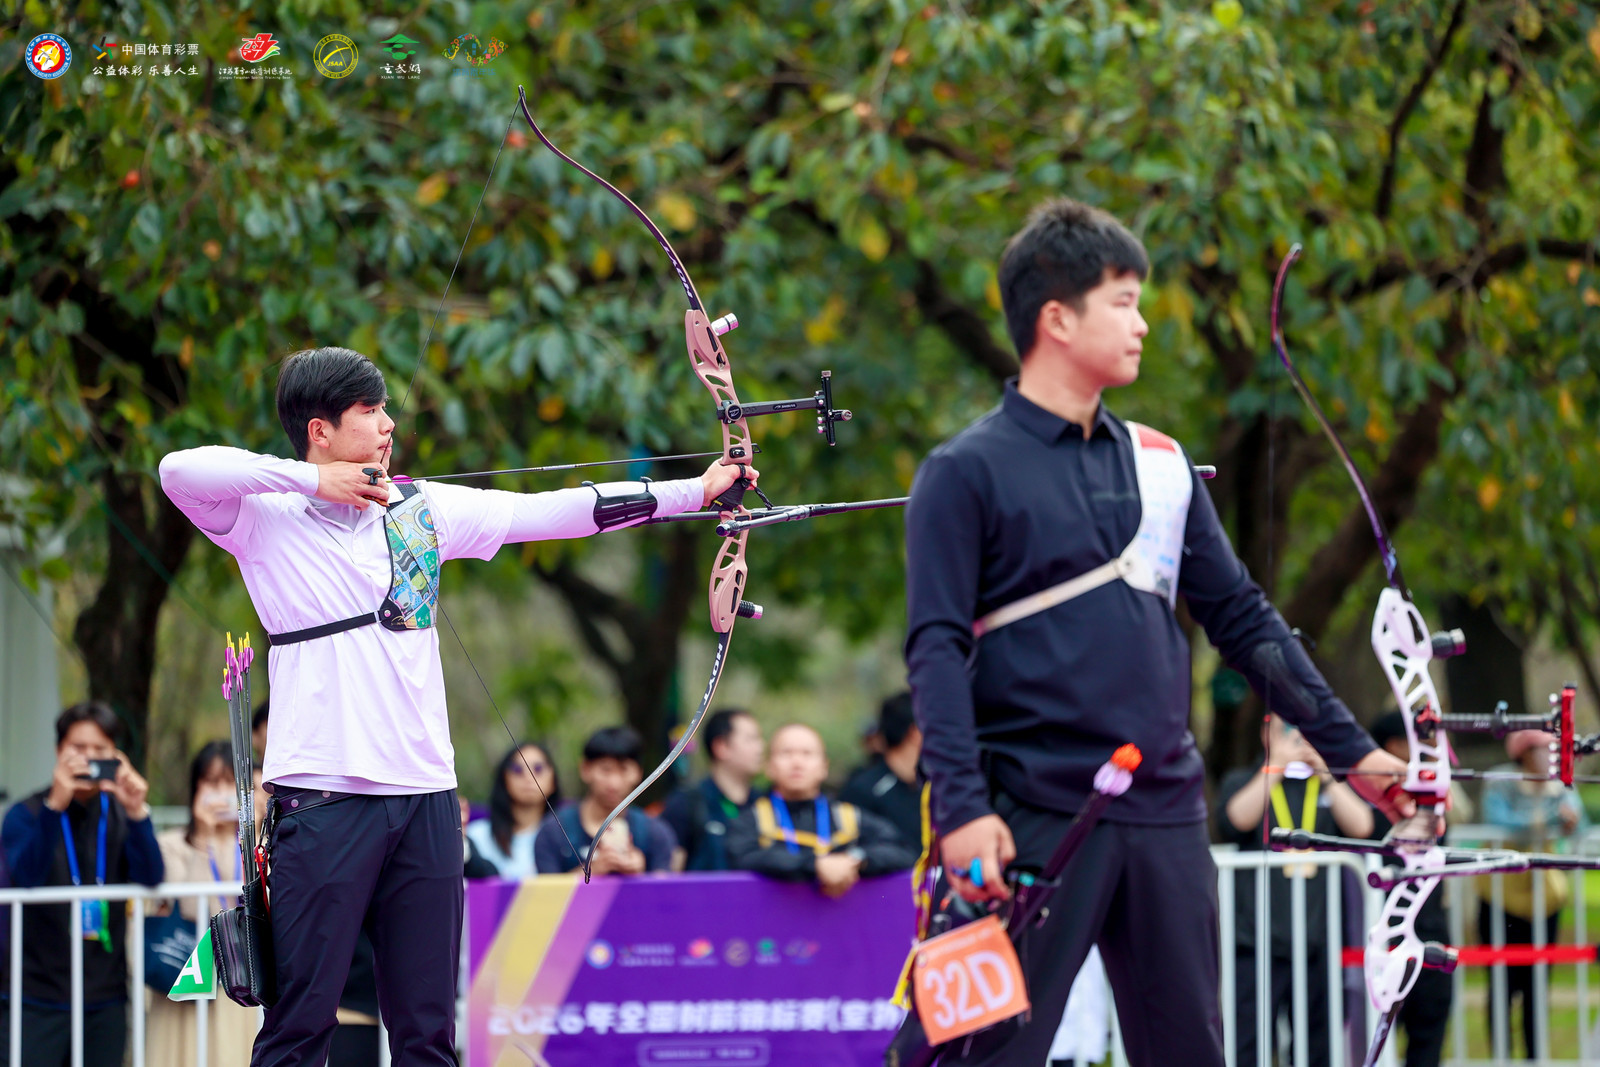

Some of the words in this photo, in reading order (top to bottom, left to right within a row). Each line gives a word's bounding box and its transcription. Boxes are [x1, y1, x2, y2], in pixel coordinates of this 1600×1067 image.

[703, 643, 723, 705] HOYT
[174, 947, 203, 986] A
[924, 950, 1015, 1029] 32D
